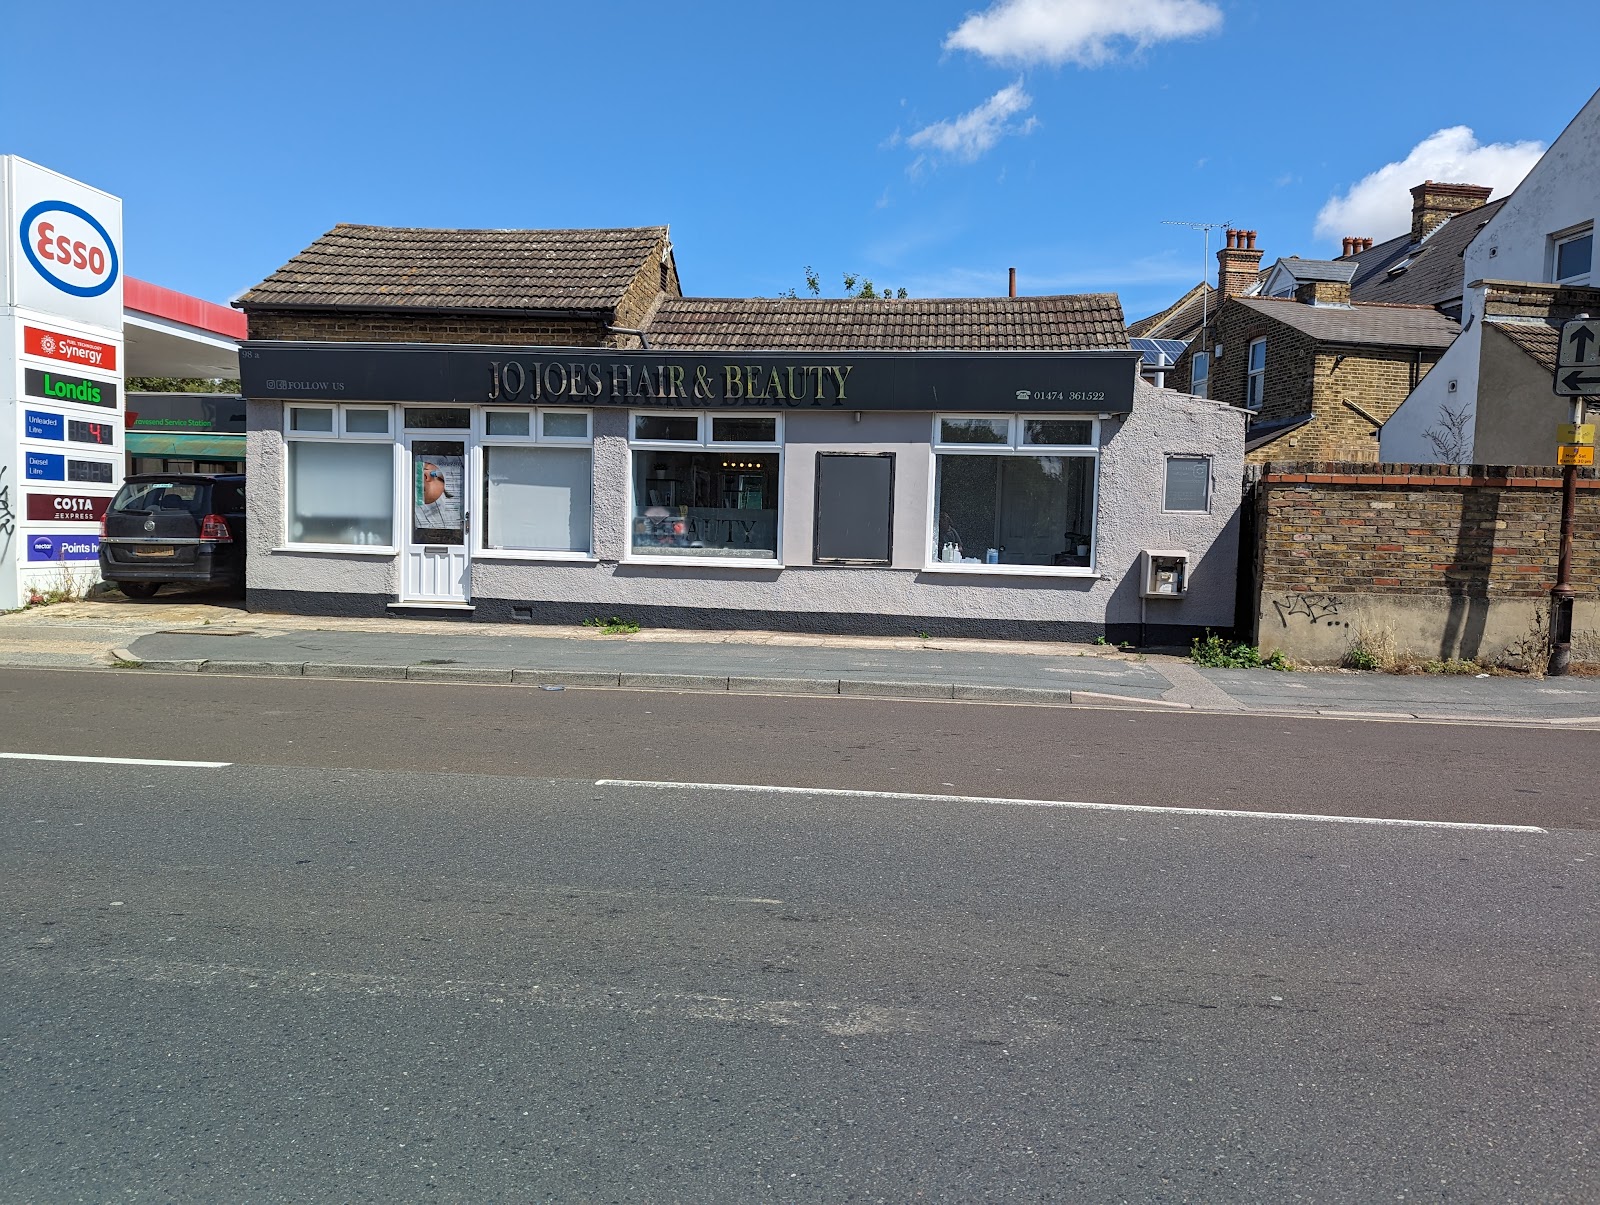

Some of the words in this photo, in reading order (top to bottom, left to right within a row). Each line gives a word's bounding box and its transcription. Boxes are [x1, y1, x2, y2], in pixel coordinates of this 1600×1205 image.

[37, 221, 105, 275] Esso
[77, 341, 102, 351] TECHNOLOGY
[59, 340, 102, 365] Synergy
[242, 351, 253, 359] 98
[488, 361, 526, 400] JO
[530, 362, 603, 400] JOES
[609, 364, 688, 398] HAIR
[694, 364, 716, 399] &
[723, 365, 853, 400] BEAUTY
[44, 374, 101, 403] Londis
[287, 381, 329, 390] FOLLOW
[332, 382, 345, 391] US
[1034, 391, 1064, 400] 01474
[1068, 391, 1105, 401] 361522
[28, 415, 58, 426] Unleaded
[134, 418, 164, 426] ravesend
[164, 418, 187, 426] Service
[188, 419, 212, 427] Station
[28, 426, 43, 434] Litre
[29, 457, 49, 466] Diesel
[29, 467, 43, 475] Litre
[54, 497, 93, 511] COSTA
[60, 512, 94, 520] EXPRESS
[61, 542, 91, 553] Points
